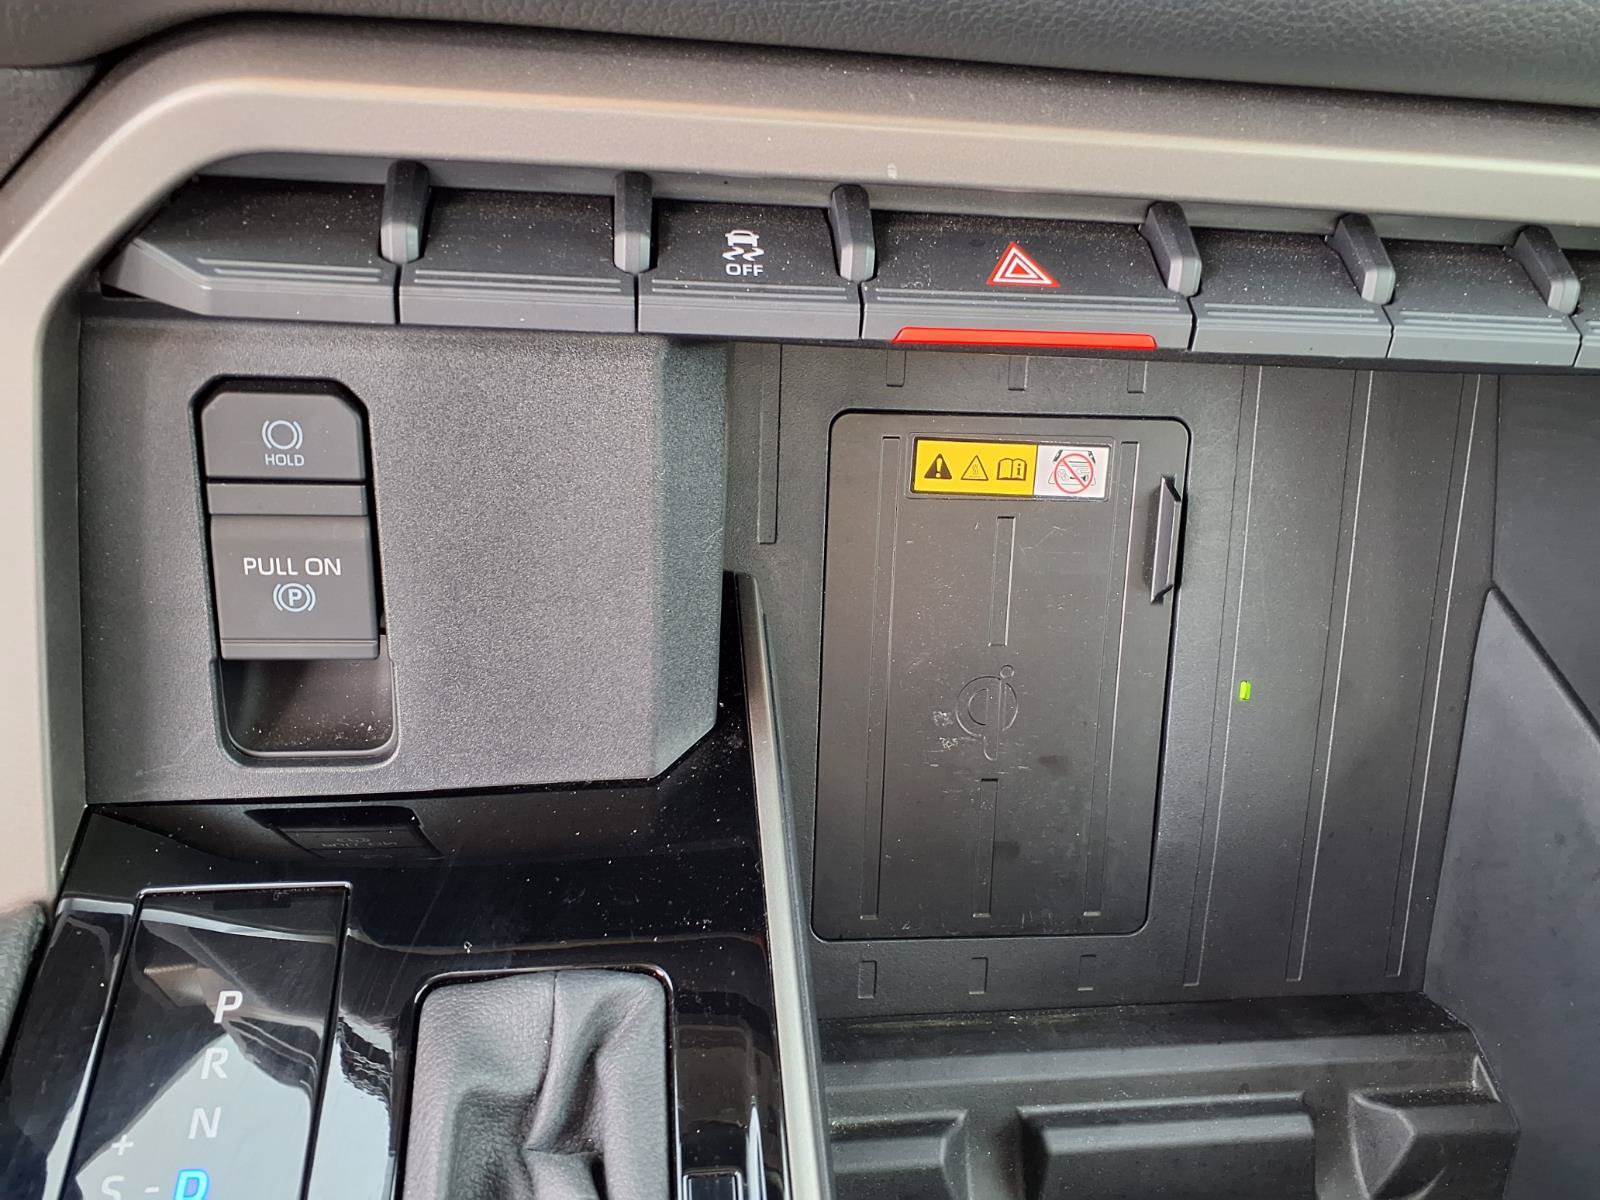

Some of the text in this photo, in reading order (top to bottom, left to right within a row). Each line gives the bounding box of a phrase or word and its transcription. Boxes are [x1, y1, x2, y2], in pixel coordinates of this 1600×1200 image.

[725, 263, 764, 277] OFF
[264, 453, 305, 467] HOLD
[243, 557, 342, 576] PULL ON
[213, 990, 243, 1024] P
[200, 1047, 228, 1080] R
[187, 1106, 222, 1140] N
[101, 1175, 125, 1200] S
[173, 1168, 210, 1200] D
